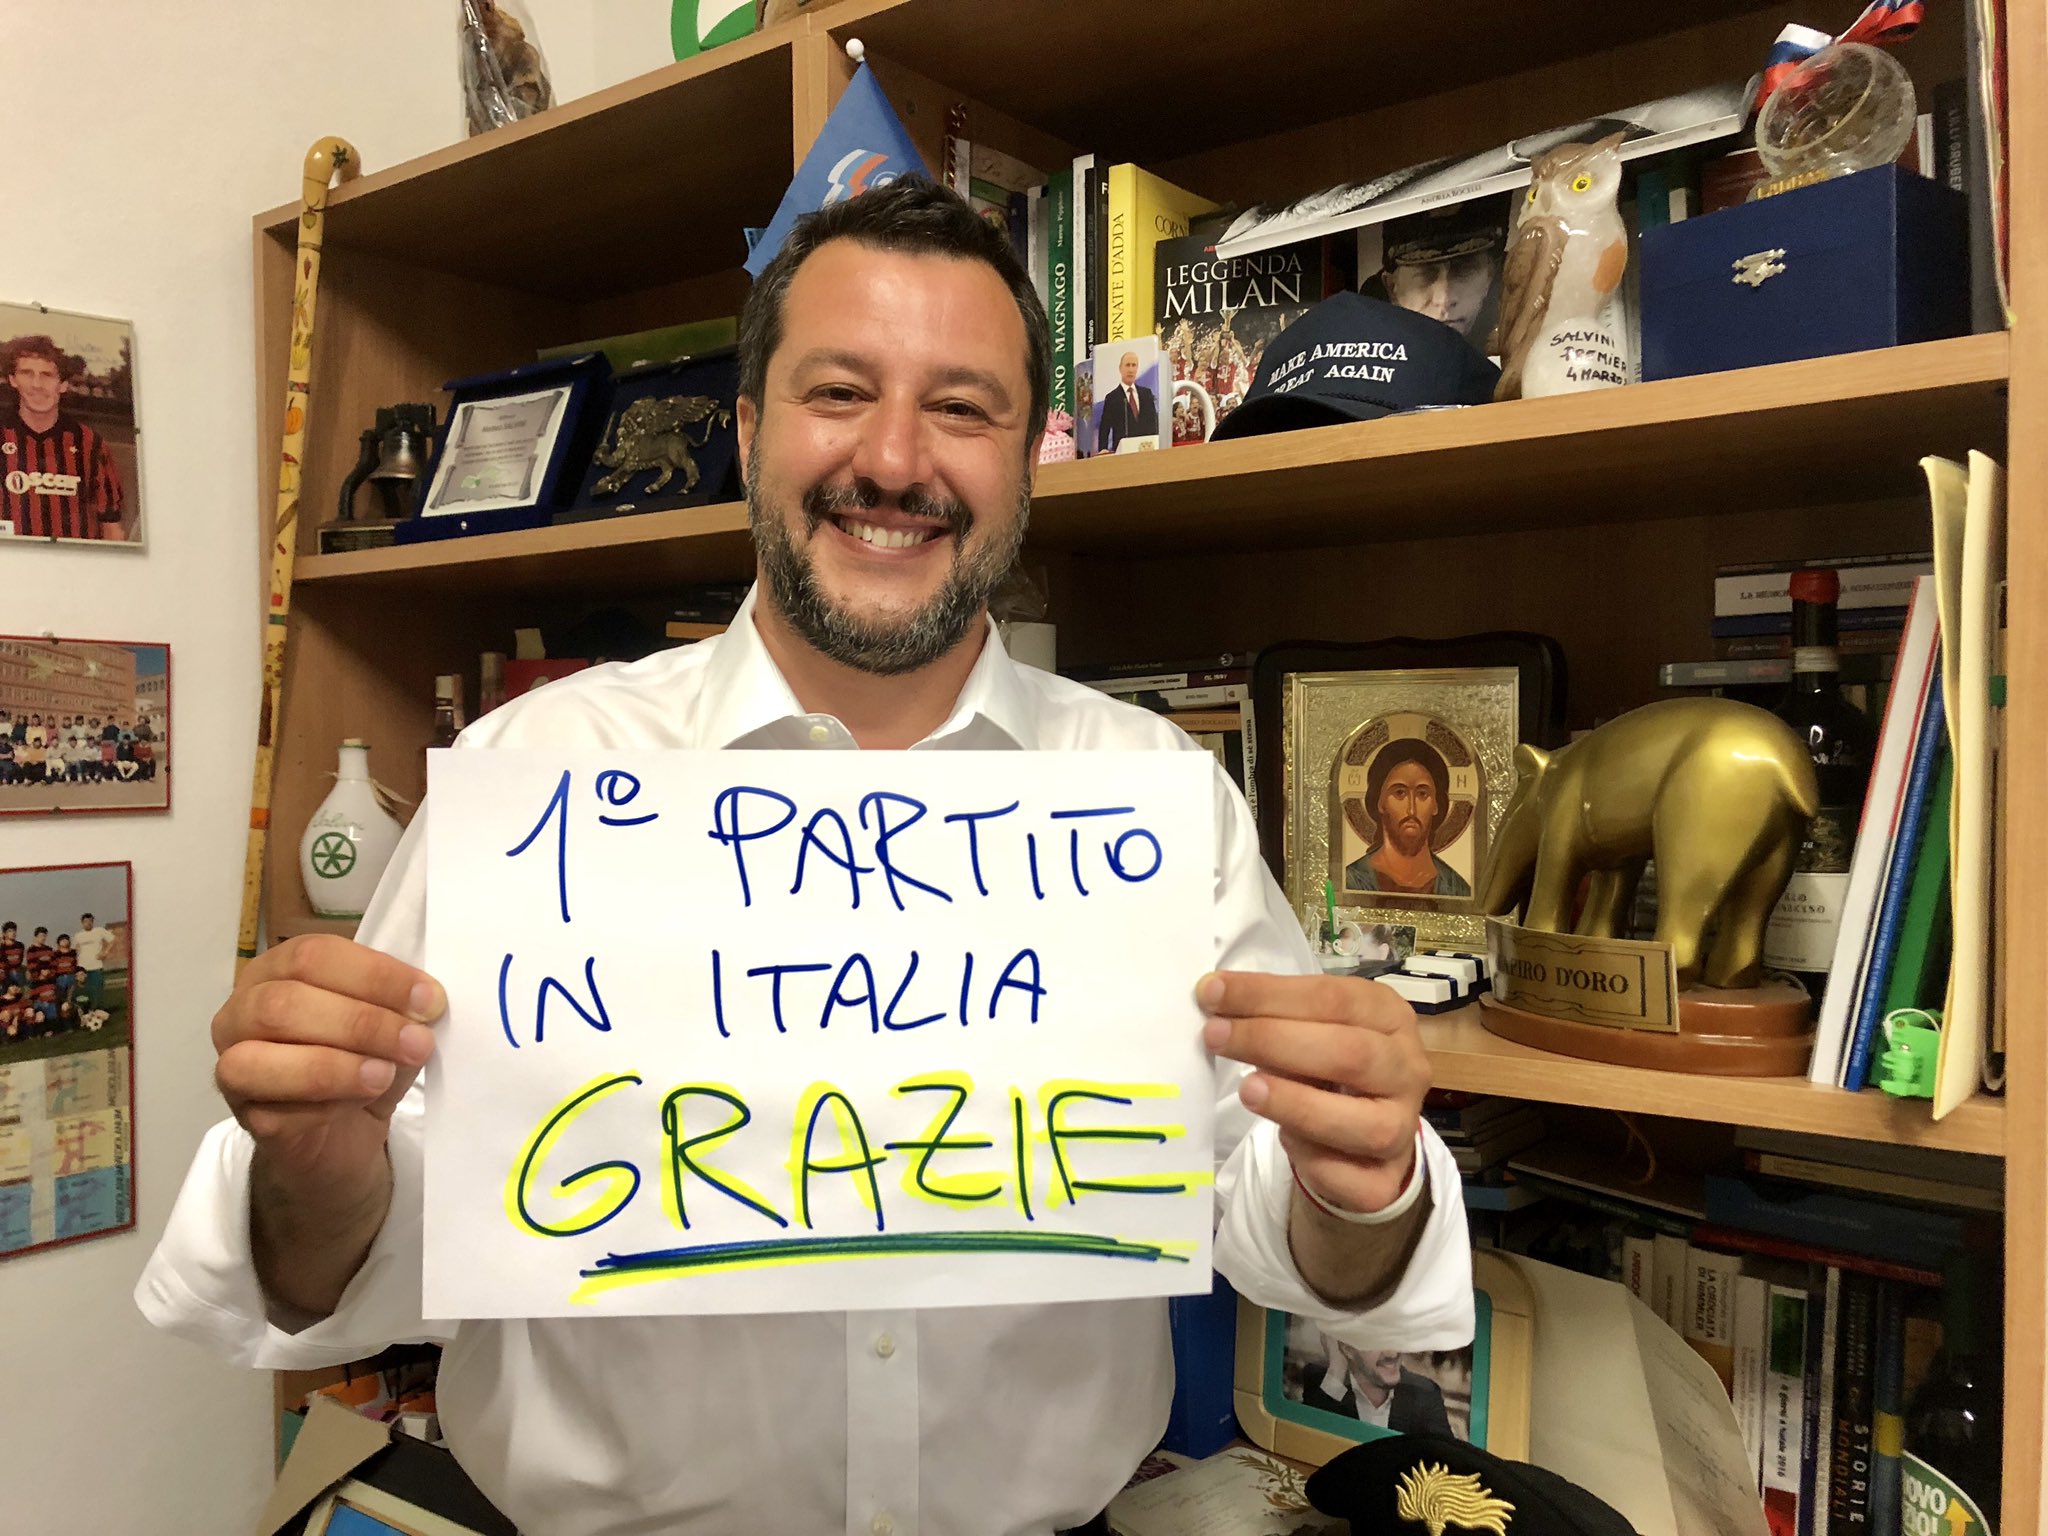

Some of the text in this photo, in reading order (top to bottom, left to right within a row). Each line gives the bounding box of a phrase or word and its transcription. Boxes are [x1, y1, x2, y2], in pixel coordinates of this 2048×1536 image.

[1112, 213, 1124, 275] D'ADDA
[1166, 252, 1303, 287] LEGGENDA
[1054, 263, 1066, 352] MAGNAGO
[1163, 273, 1303, 319] MILAN
[1267, 342, 1408, 387] MAKE AMERICA
[1550, 331, 1615, 348] SALVINI
[1324, 364, 1395, 383] AGAIN
[1566, 367, 1577, 381] 4
[708, 785, 1163, 910] PARTITO
[498, 948, 1047, 1048] IN ITALIA
[1554, 967, 1629, 994] D'ORO
[514, 1073, 1189, 1238] GRAZIE
[1706, 1285, 1717, 1338] CROCIATA
[1832, 1418, 1849, 1519] MONDIALI
[1850, 1424, 1869, 1523] STORIE
